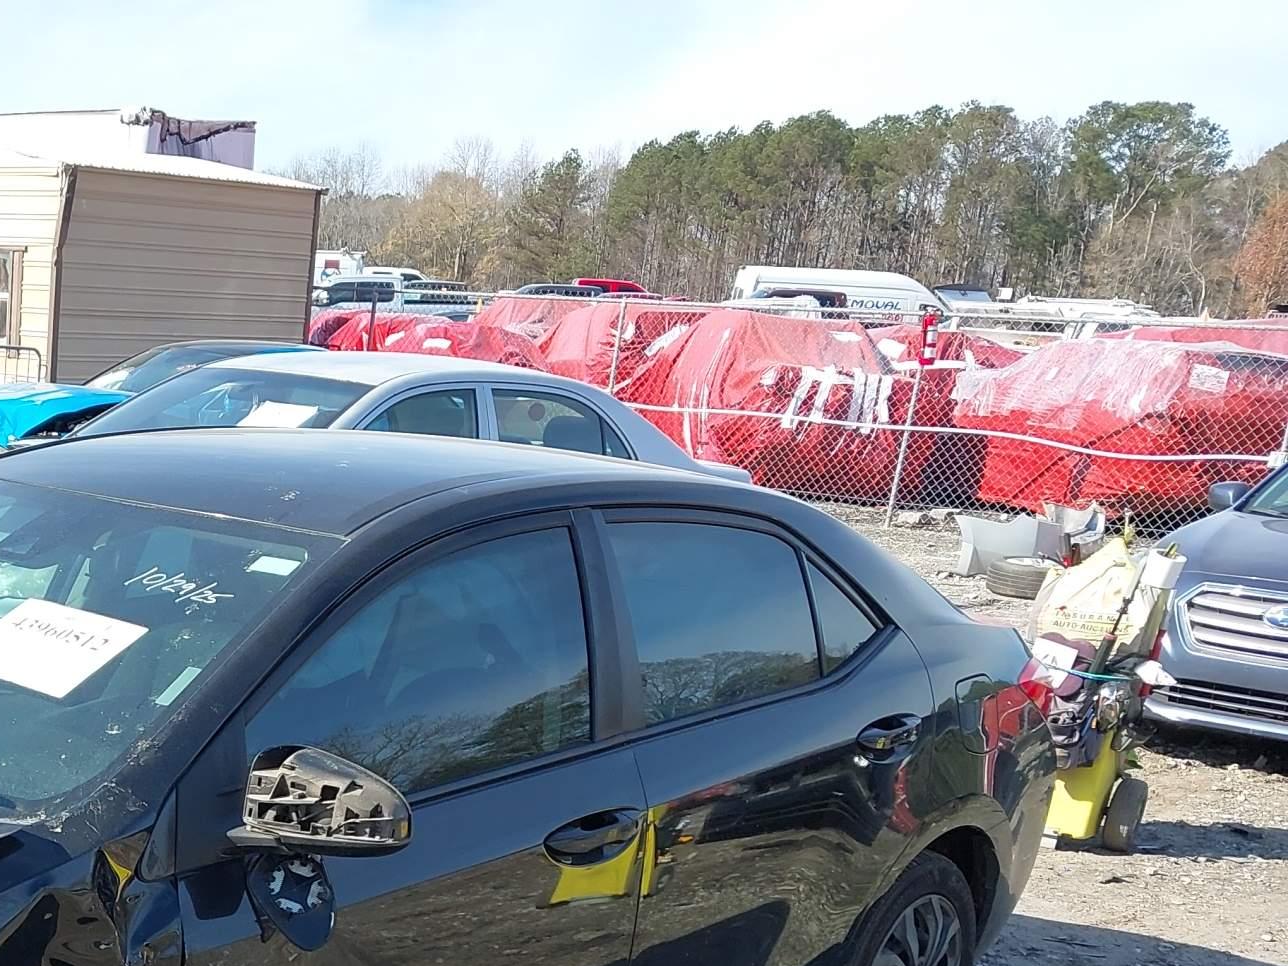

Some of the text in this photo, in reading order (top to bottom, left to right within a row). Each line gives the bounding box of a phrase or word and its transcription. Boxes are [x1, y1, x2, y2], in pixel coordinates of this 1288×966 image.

[849, 299, 902, 311] MOVAL
[123, 566, 235, 604] 10/29/25
[1055, 609, 1129, 622] INSURAN
[1053, 619, 1078, 629] AUTO
